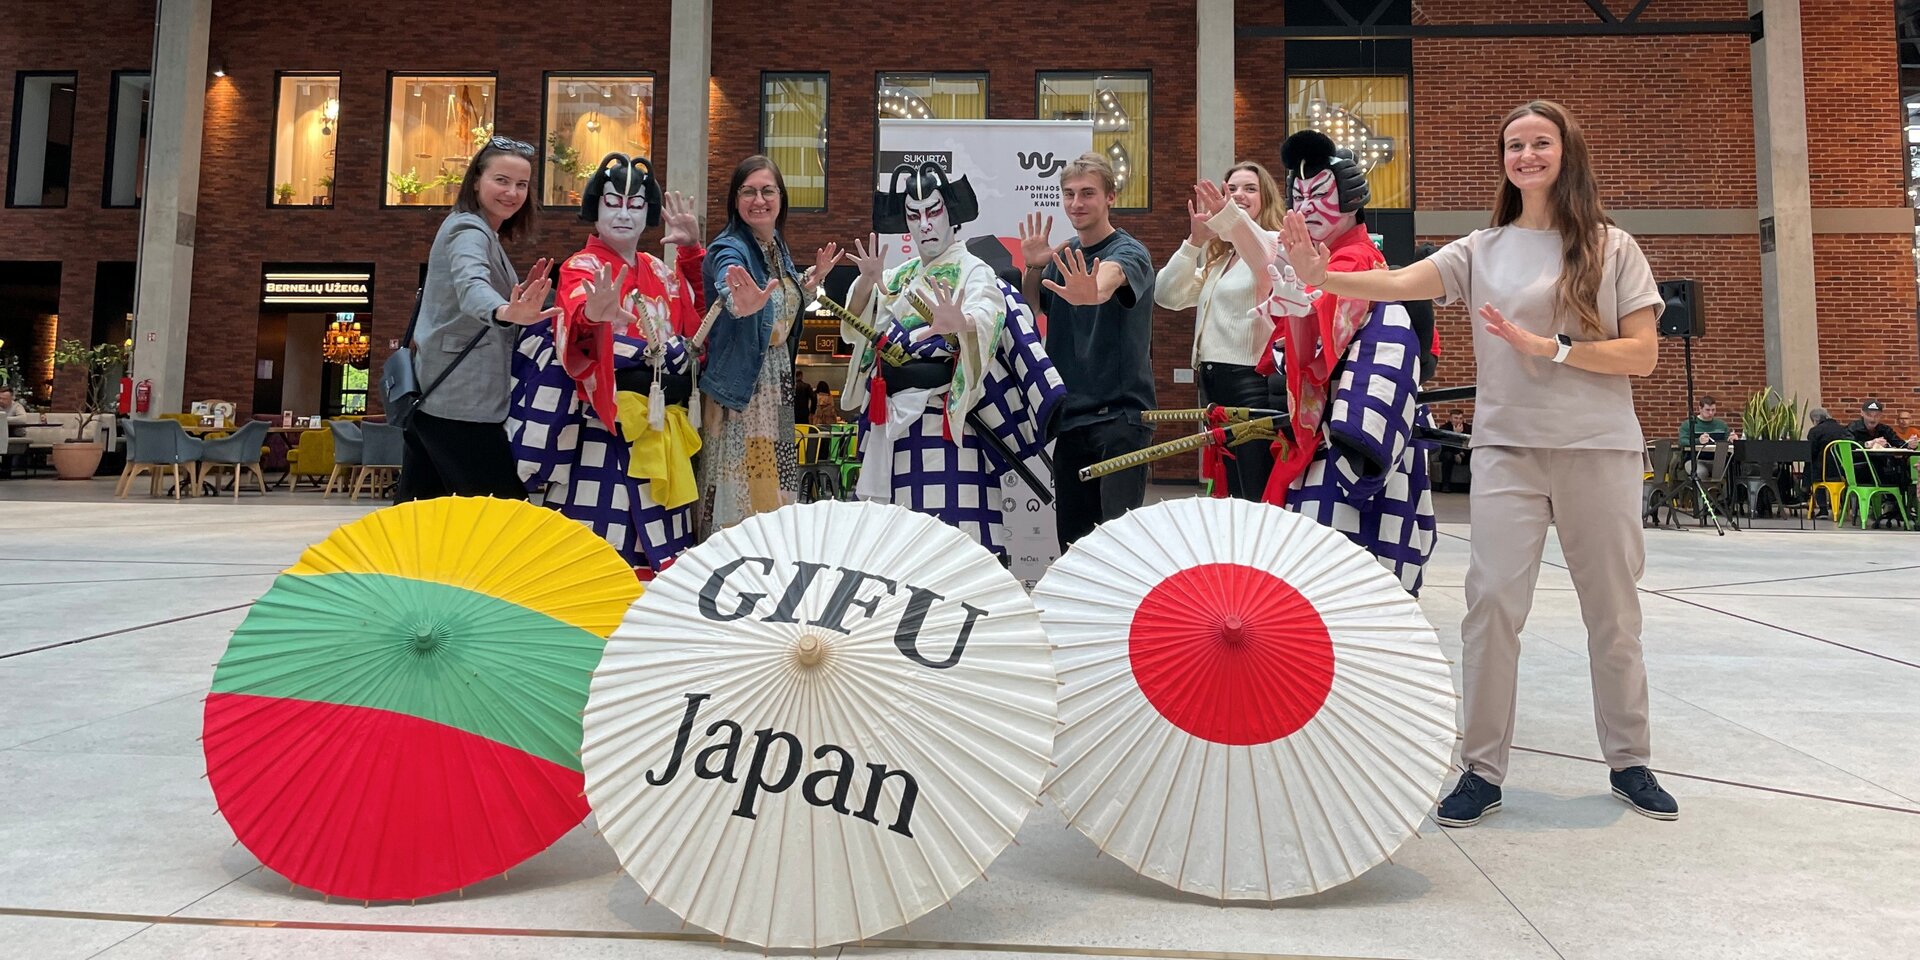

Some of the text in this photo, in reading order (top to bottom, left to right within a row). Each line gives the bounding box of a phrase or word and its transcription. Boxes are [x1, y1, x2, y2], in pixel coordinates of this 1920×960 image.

[903, 154, 948, 163] SUKURTA
[325, 282, 368, 292] UŽEIGA
[698, 556, 989, 669] GIFU
[645, 693, 919, 839] Japan
